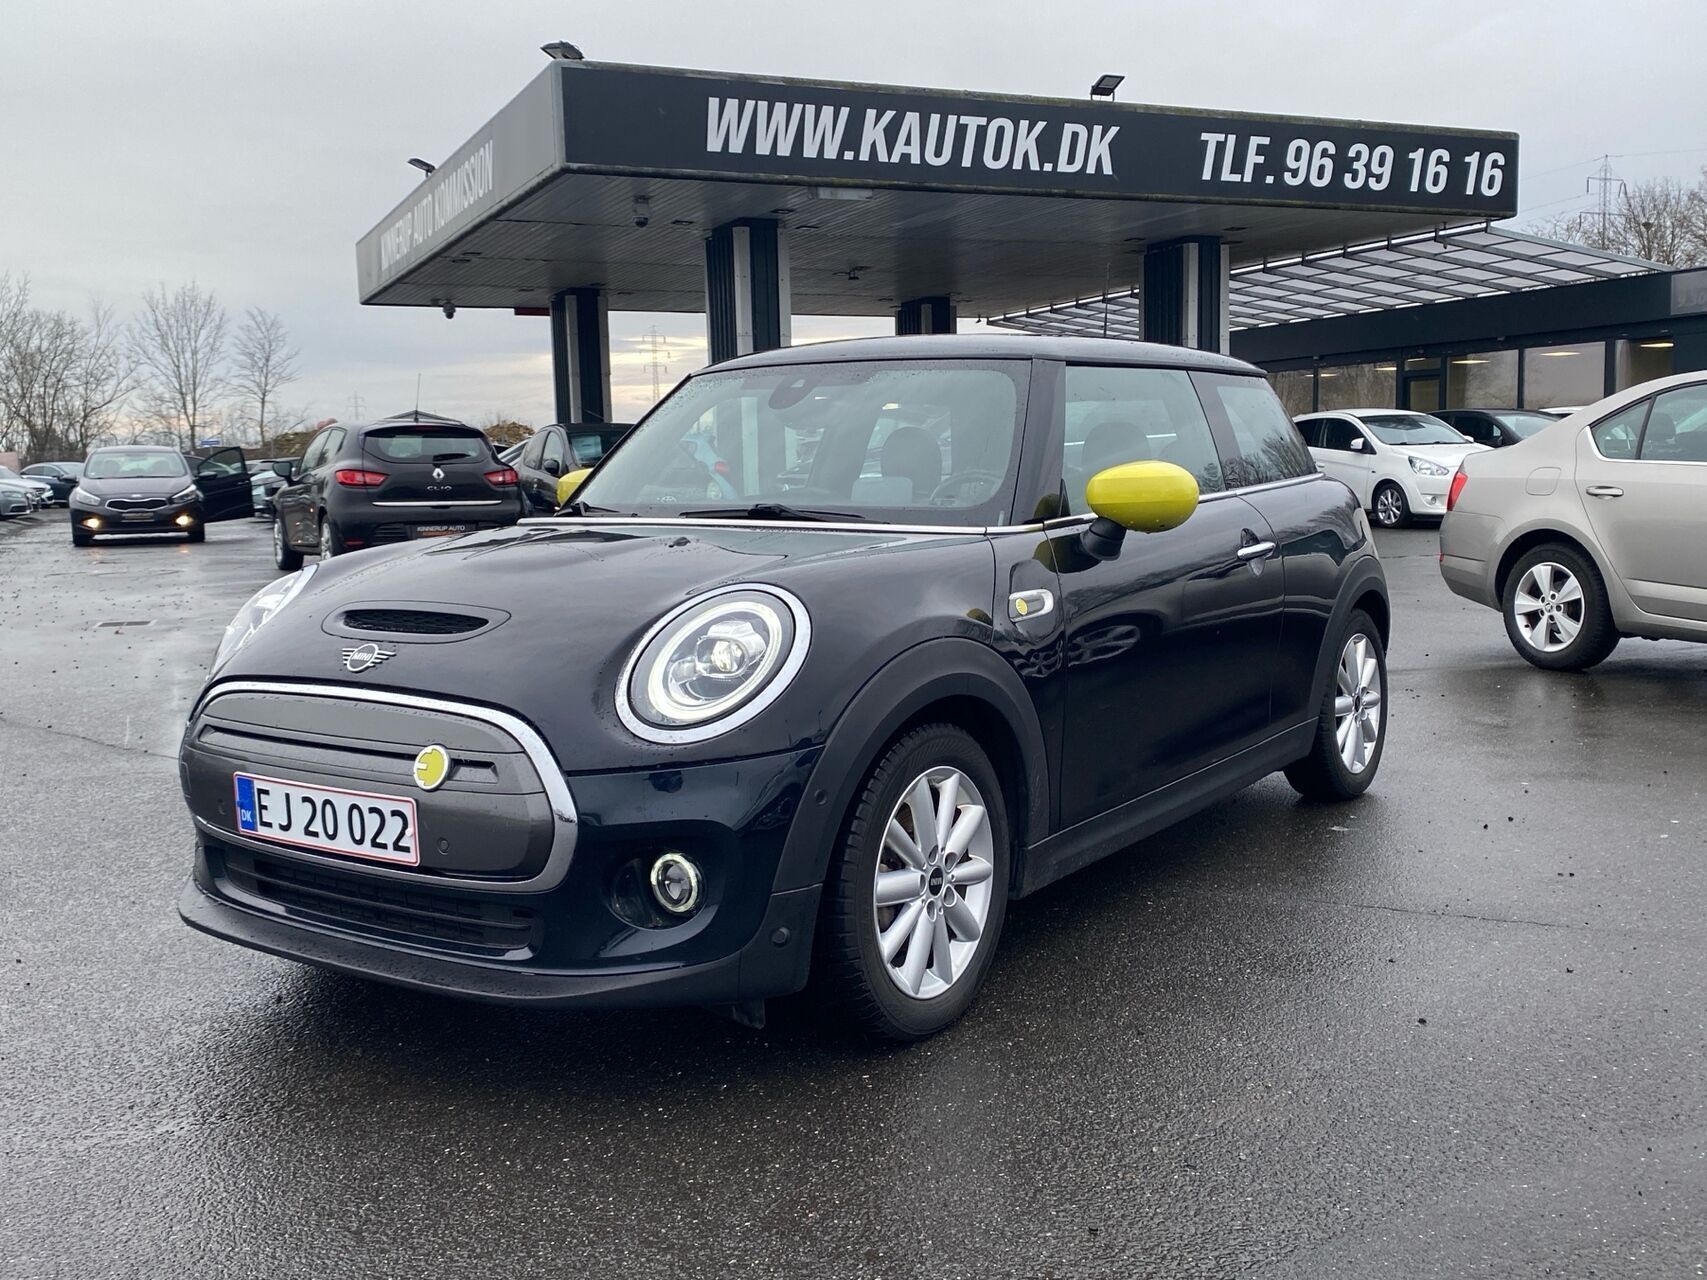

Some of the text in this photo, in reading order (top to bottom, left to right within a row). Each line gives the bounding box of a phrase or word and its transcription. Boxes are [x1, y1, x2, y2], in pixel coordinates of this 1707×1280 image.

[706, 96, 1506, 197] WWW.KAUTOK.DK TLF. 96 39 16 16
[413, 193, 433, 248] AUTO
[241, 809, 253, 823] DK
[256, 788, 411, 853] EJ 20 022
